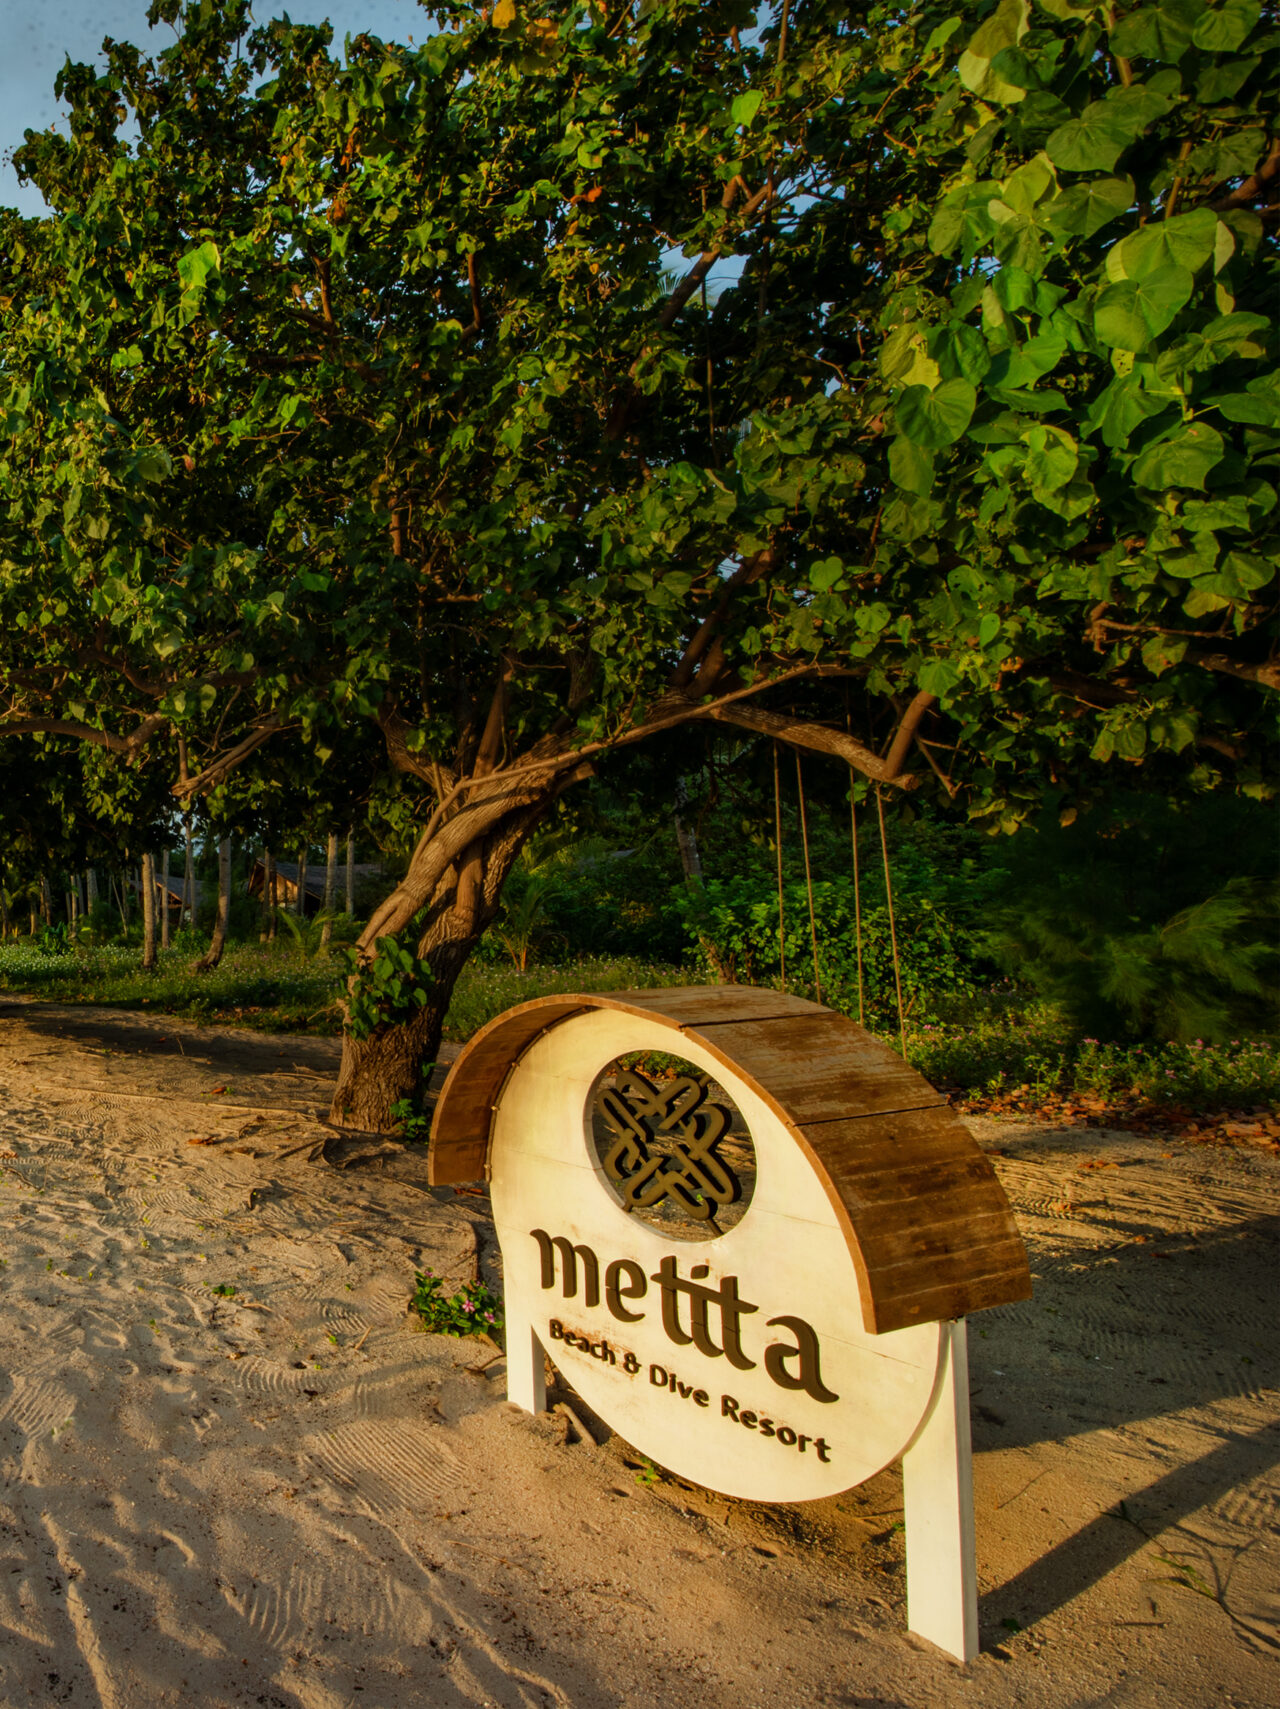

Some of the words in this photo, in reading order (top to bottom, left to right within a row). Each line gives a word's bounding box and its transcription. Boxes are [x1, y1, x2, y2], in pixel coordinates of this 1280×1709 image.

[548, 1318, 616, 1366] Beach
[622, 1351, 642, 1375] &
[649, 1364, 710, 1407] Dive
[720, 1394, 832, 1464] Resort
